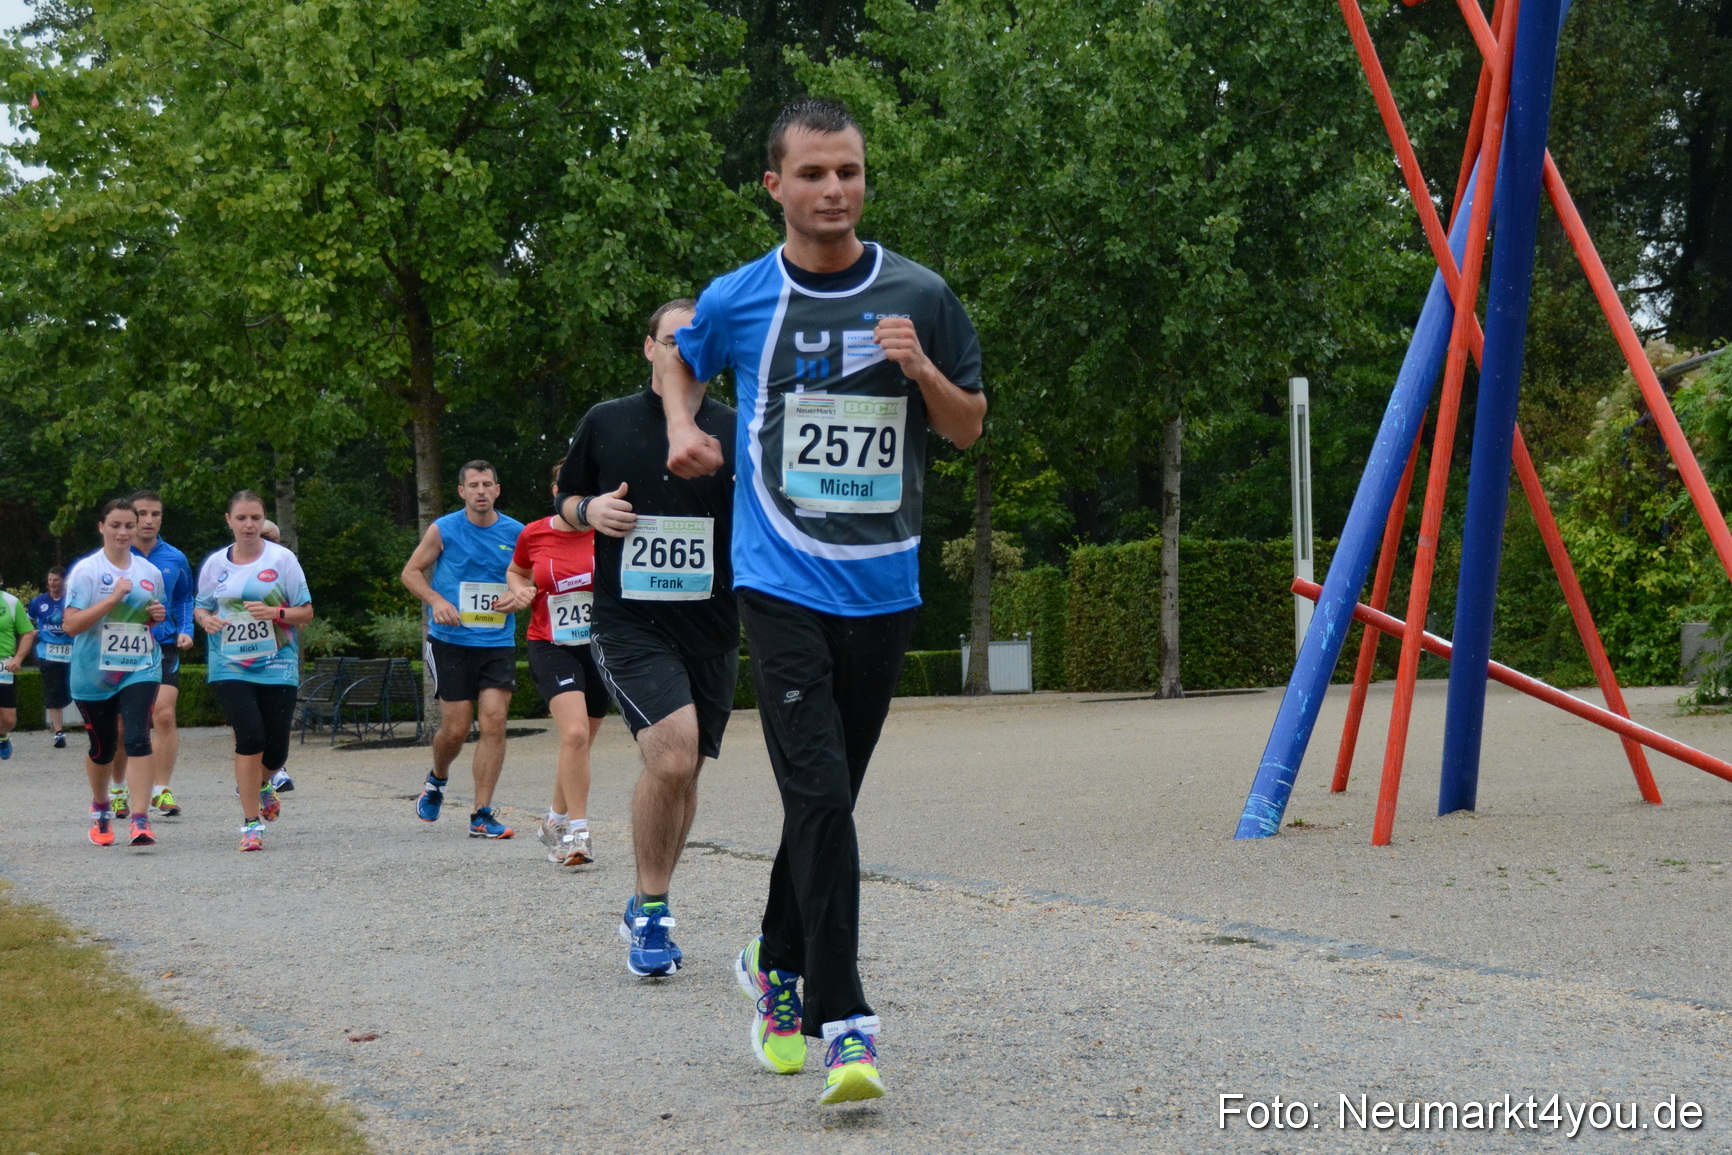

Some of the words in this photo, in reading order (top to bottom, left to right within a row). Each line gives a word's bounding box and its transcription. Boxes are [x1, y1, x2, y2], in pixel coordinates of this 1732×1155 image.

[796, 407, 836, 415] NeuerMarkt
[843, 400, 899, 416] BOCK
[798, 423, 897, 468] 2579
[788, 461, 794, 469] B
[820, 478, 874, 497] Michal
[662, 519, 706, 531] BOCK
[631, 536, 706, 569] 2665
[650, 576, 683, 589] Frank
[227, 620, 269, 643] 2283
[49, 645, 70, 654] 2118
[108, 634, 148, 653] 2441
[240, 644, 258, 653] Nicki
[120, 657, 138, 665] Jana
